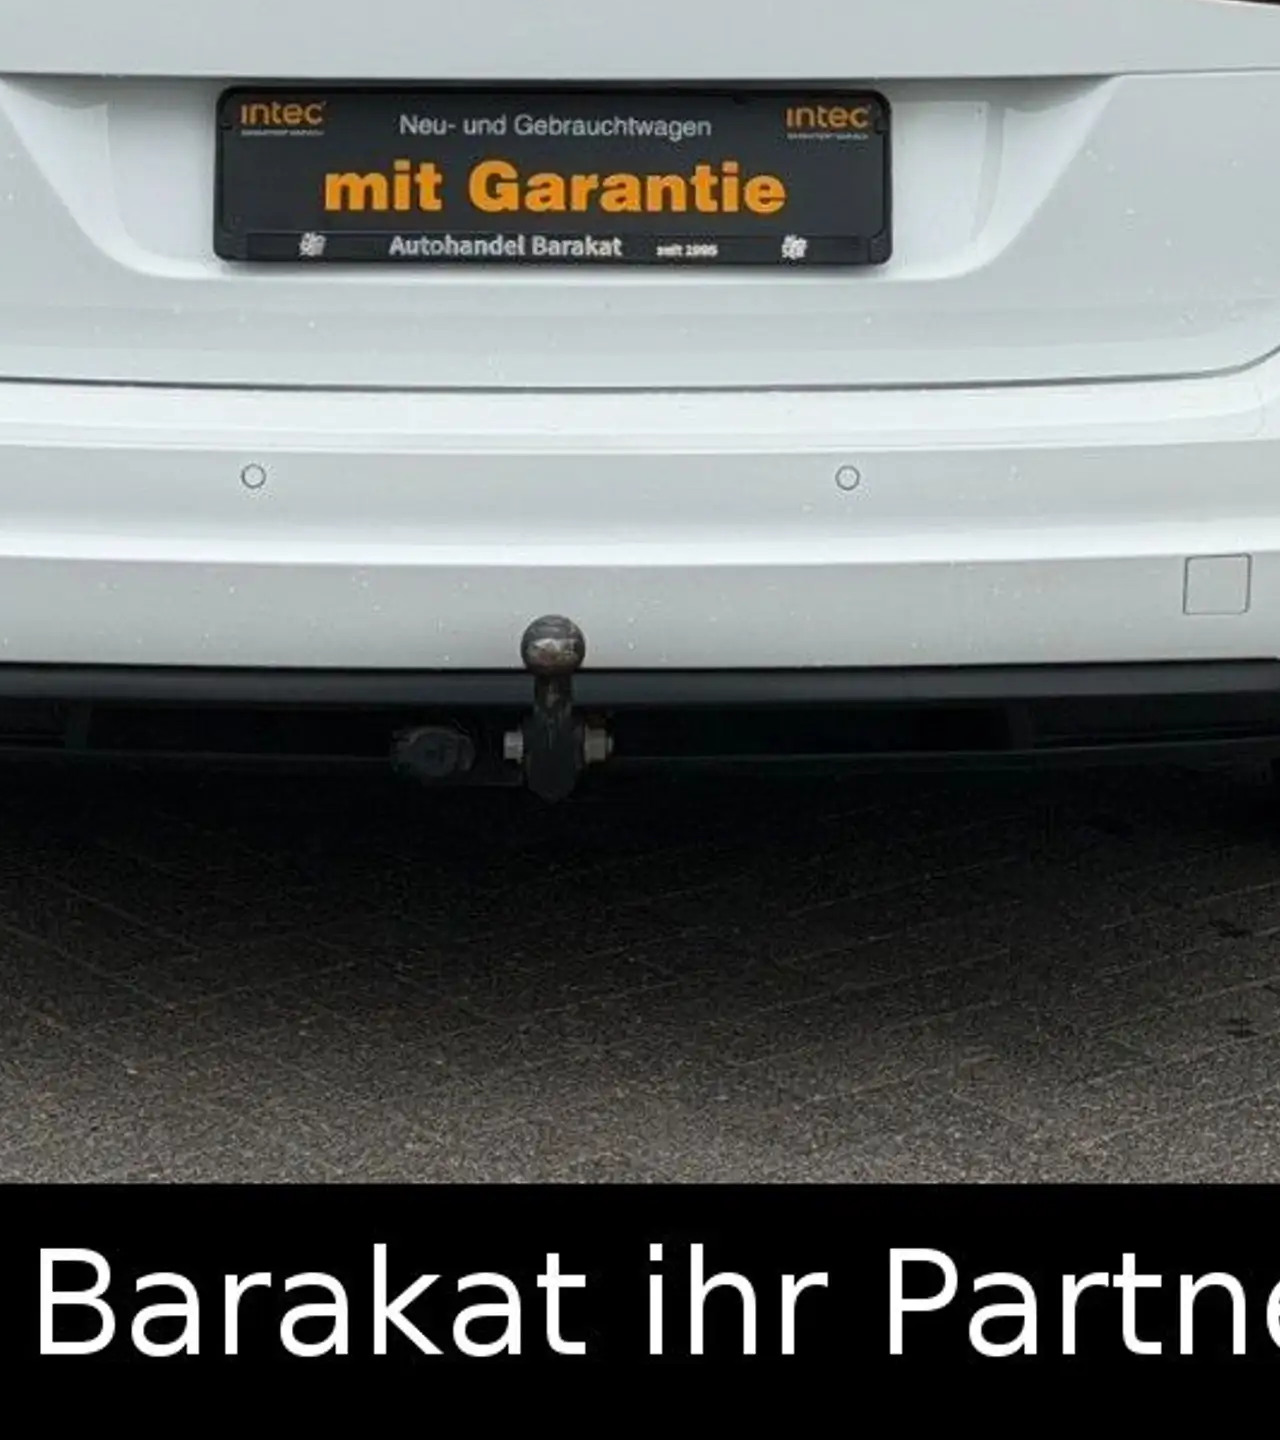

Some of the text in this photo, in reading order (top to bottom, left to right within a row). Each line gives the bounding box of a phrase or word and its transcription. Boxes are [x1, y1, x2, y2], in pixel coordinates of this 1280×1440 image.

[241, 101, 323, 126] intec
[786, 106, 869, 129] intec
[400, 114, 713, 143] Neu- und Gebrauchtwagen
[323, 159, 787, 216] mit Garantie
[389, 234, 623, 257] Autohandel Barakat
